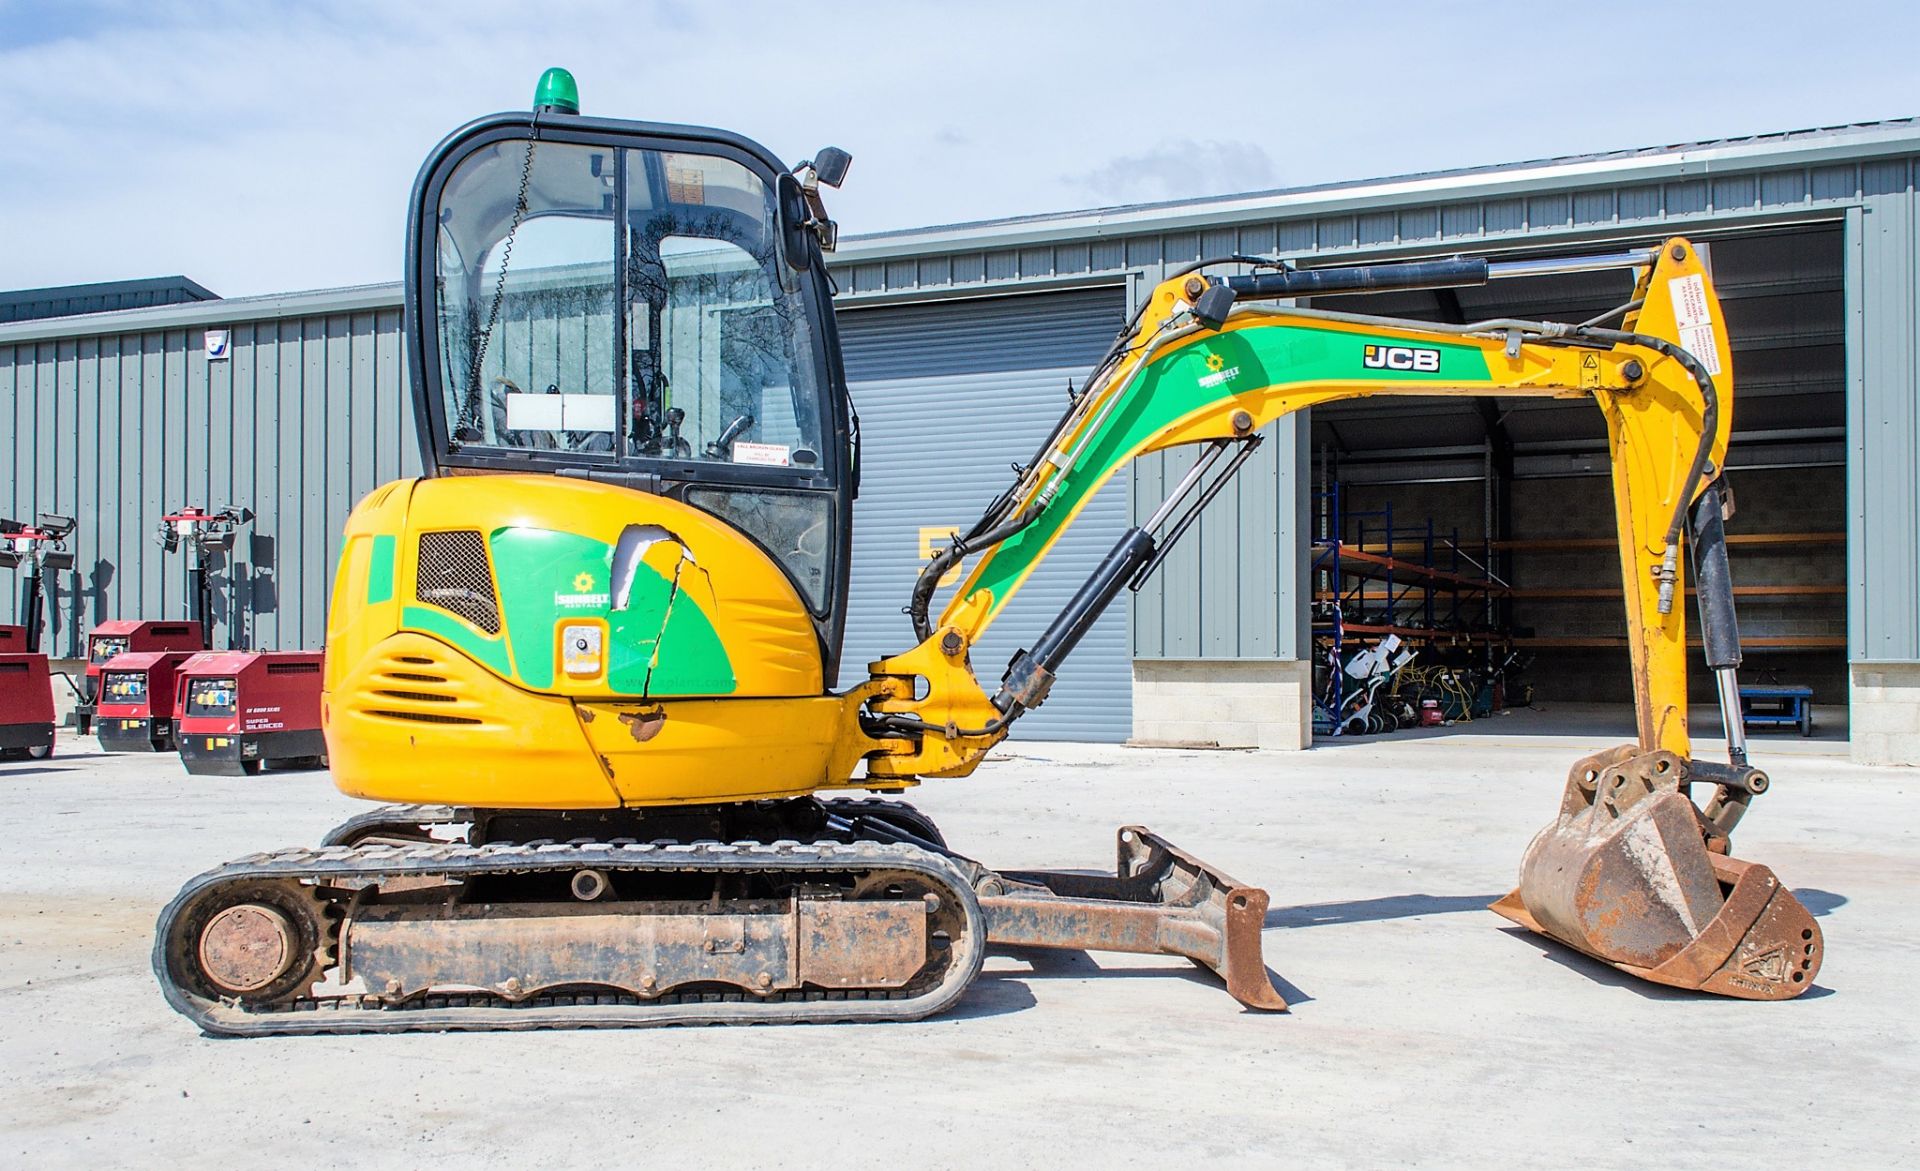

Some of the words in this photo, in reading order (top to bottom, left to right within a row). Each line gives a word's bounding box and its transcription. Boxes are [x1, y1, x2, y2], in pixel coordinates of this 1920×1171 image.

[1365, 346, 1439, 371] JCB
[558, 594, 609, 605] SUNBELT
[246, 722, 284, 730] SILENCED
